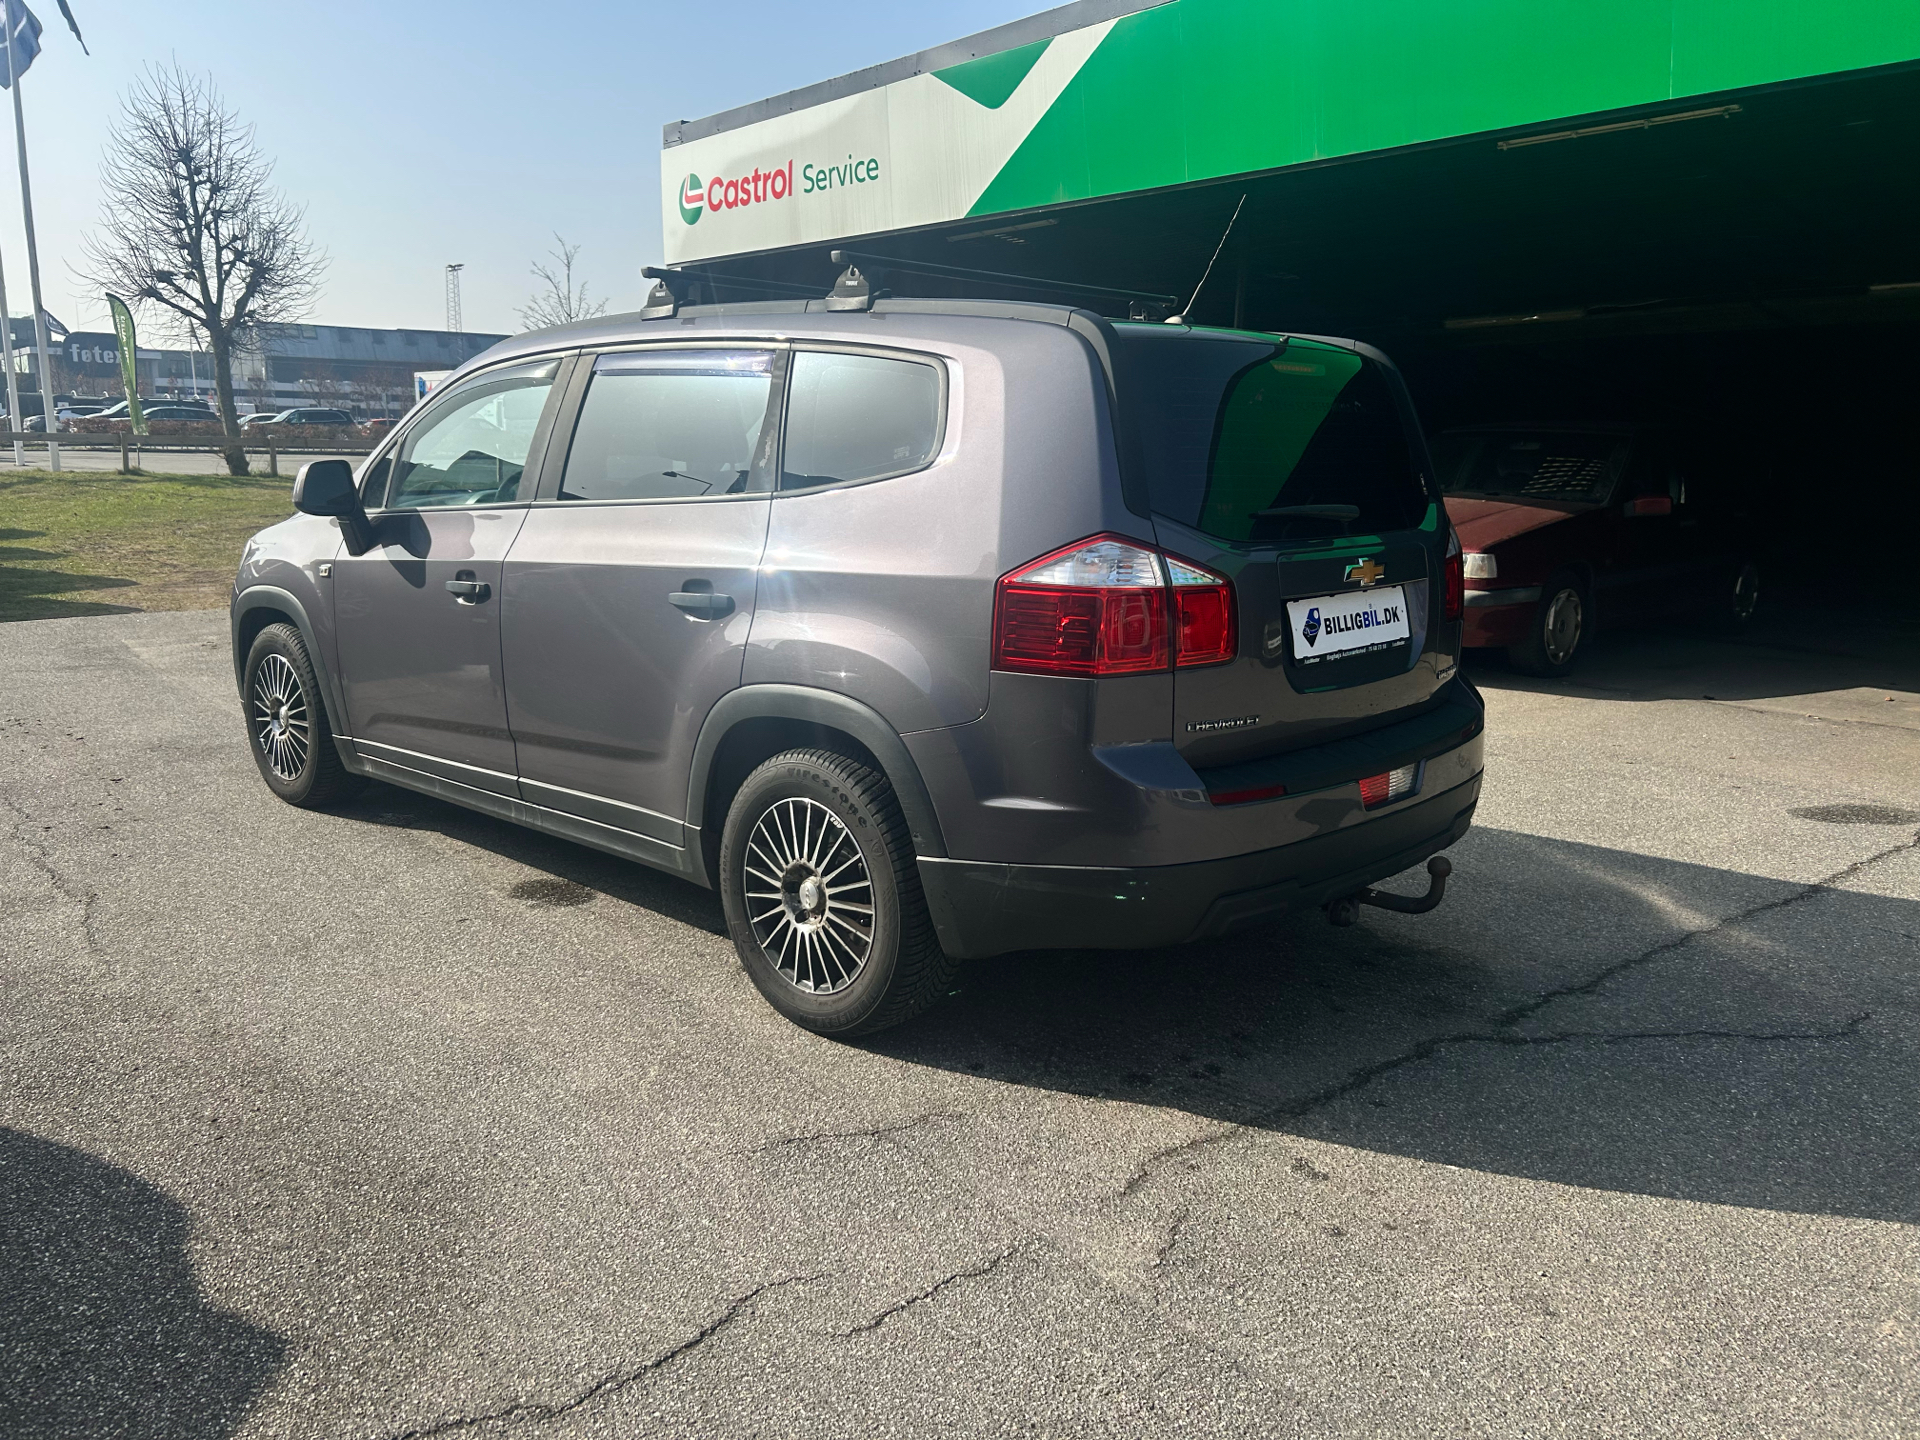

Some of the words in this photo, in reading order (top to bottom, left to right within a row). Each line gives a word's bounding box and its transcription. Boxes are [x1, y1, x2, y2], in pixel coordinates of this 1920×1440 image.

[707, 159, 793, 212] Castrol
[803, 154, 879, 194] Service
[1323, 606, 1400, 635] BILLIGBIL.DK
[1186, 715, 1260, 732] CHEVROLET
[787, 767, 868, 828] Firestone
